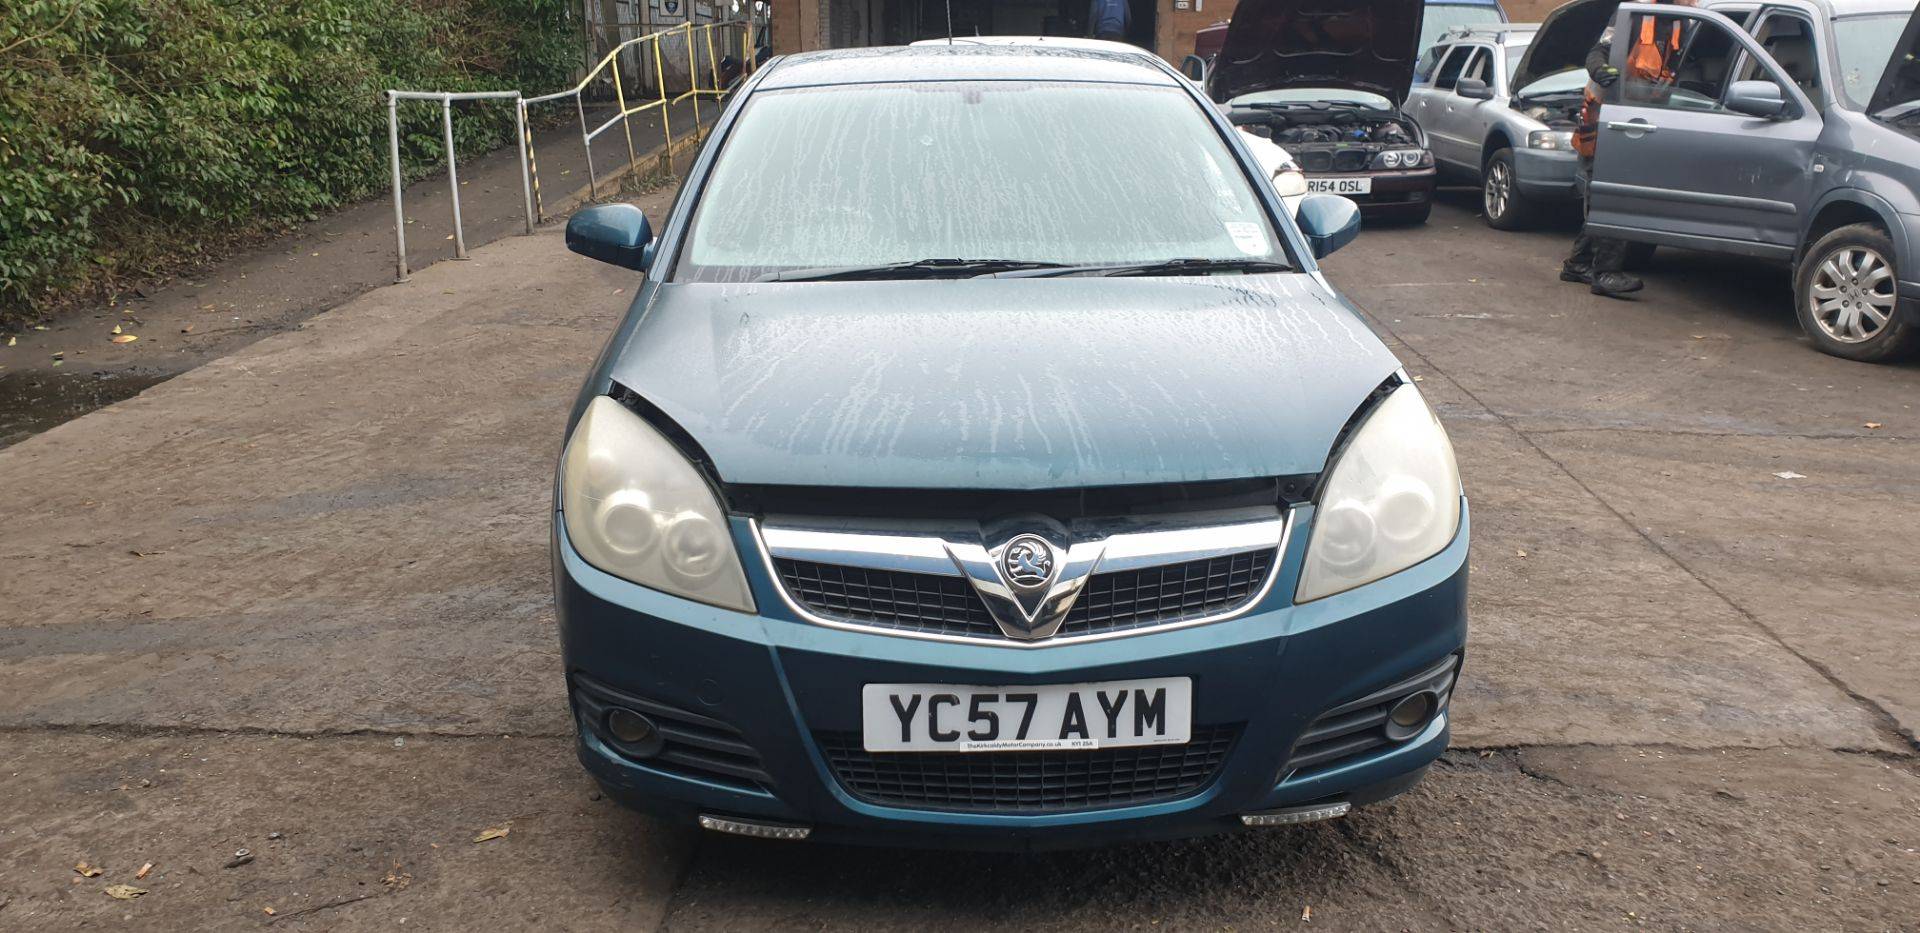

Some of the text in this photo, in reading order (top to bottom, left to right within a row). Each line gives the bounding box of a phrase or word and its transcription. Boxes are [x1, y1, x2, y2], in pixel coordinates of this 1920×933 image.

[1339, 180, 1362, 192] OSL
[889, 688, 1166, 742] YC57 AYM
